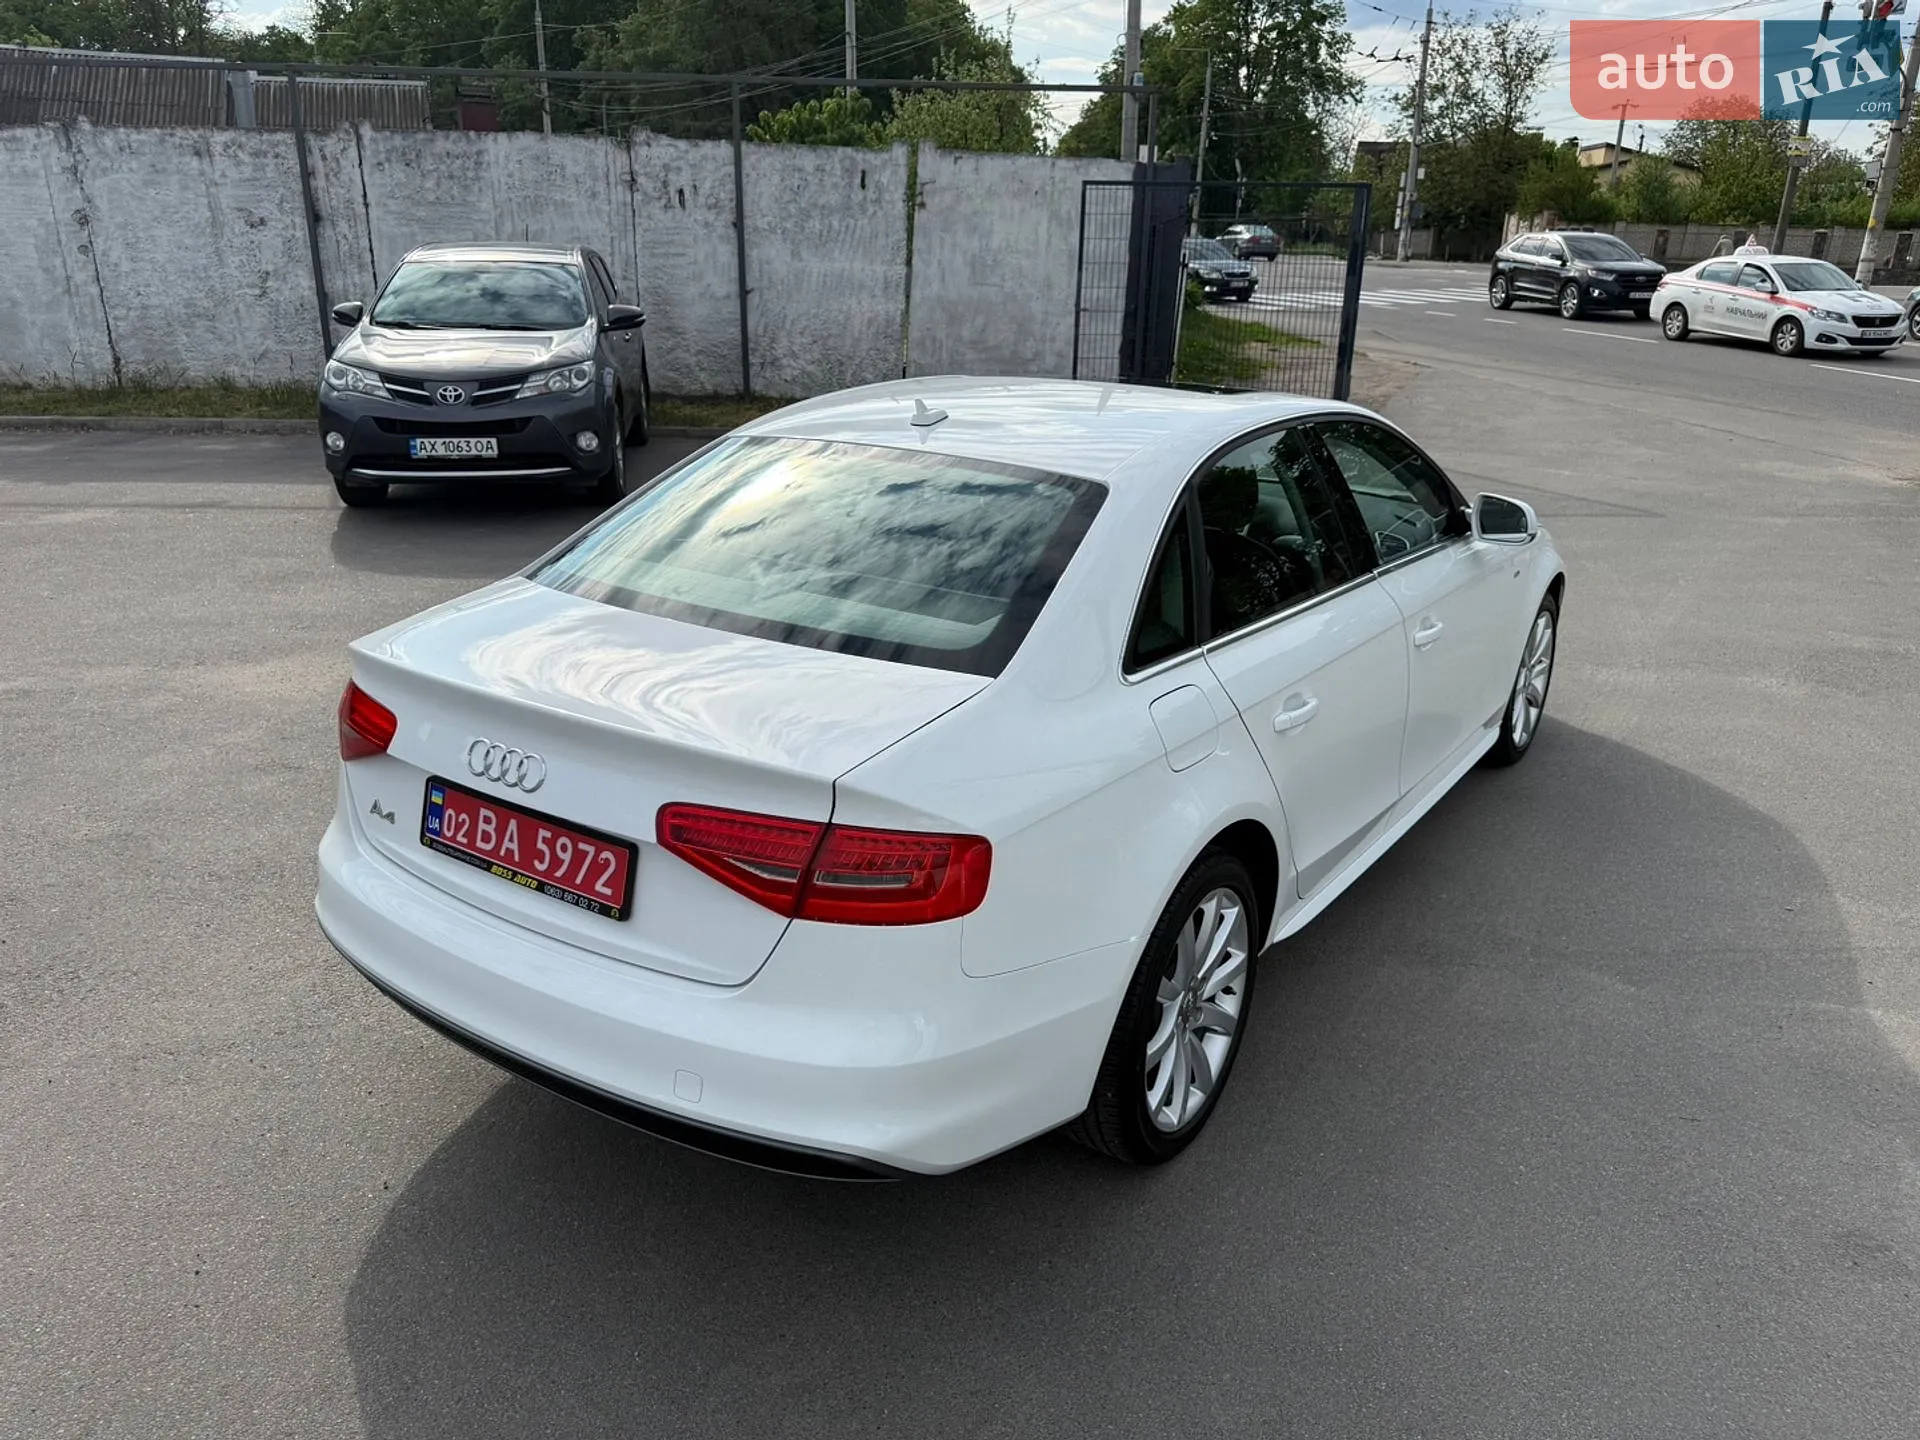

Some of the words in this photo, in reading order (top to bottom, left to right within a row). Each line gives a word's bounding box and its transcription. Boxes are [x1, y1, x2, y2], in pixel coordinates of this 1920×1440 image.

[420, 440, 438, 453] AX
[441, 440, 472, 453] 1063
[474, 440, 495, 453] OA
[428, 815, 440, 832] UA
[443, 808, 471, 844] 02
[476, 806, 519, 862] BA
[533, 826, 616, 897] 5972
[490, 865, 513, 879] BOSS
[514, 874, 538, 889] AUTO
